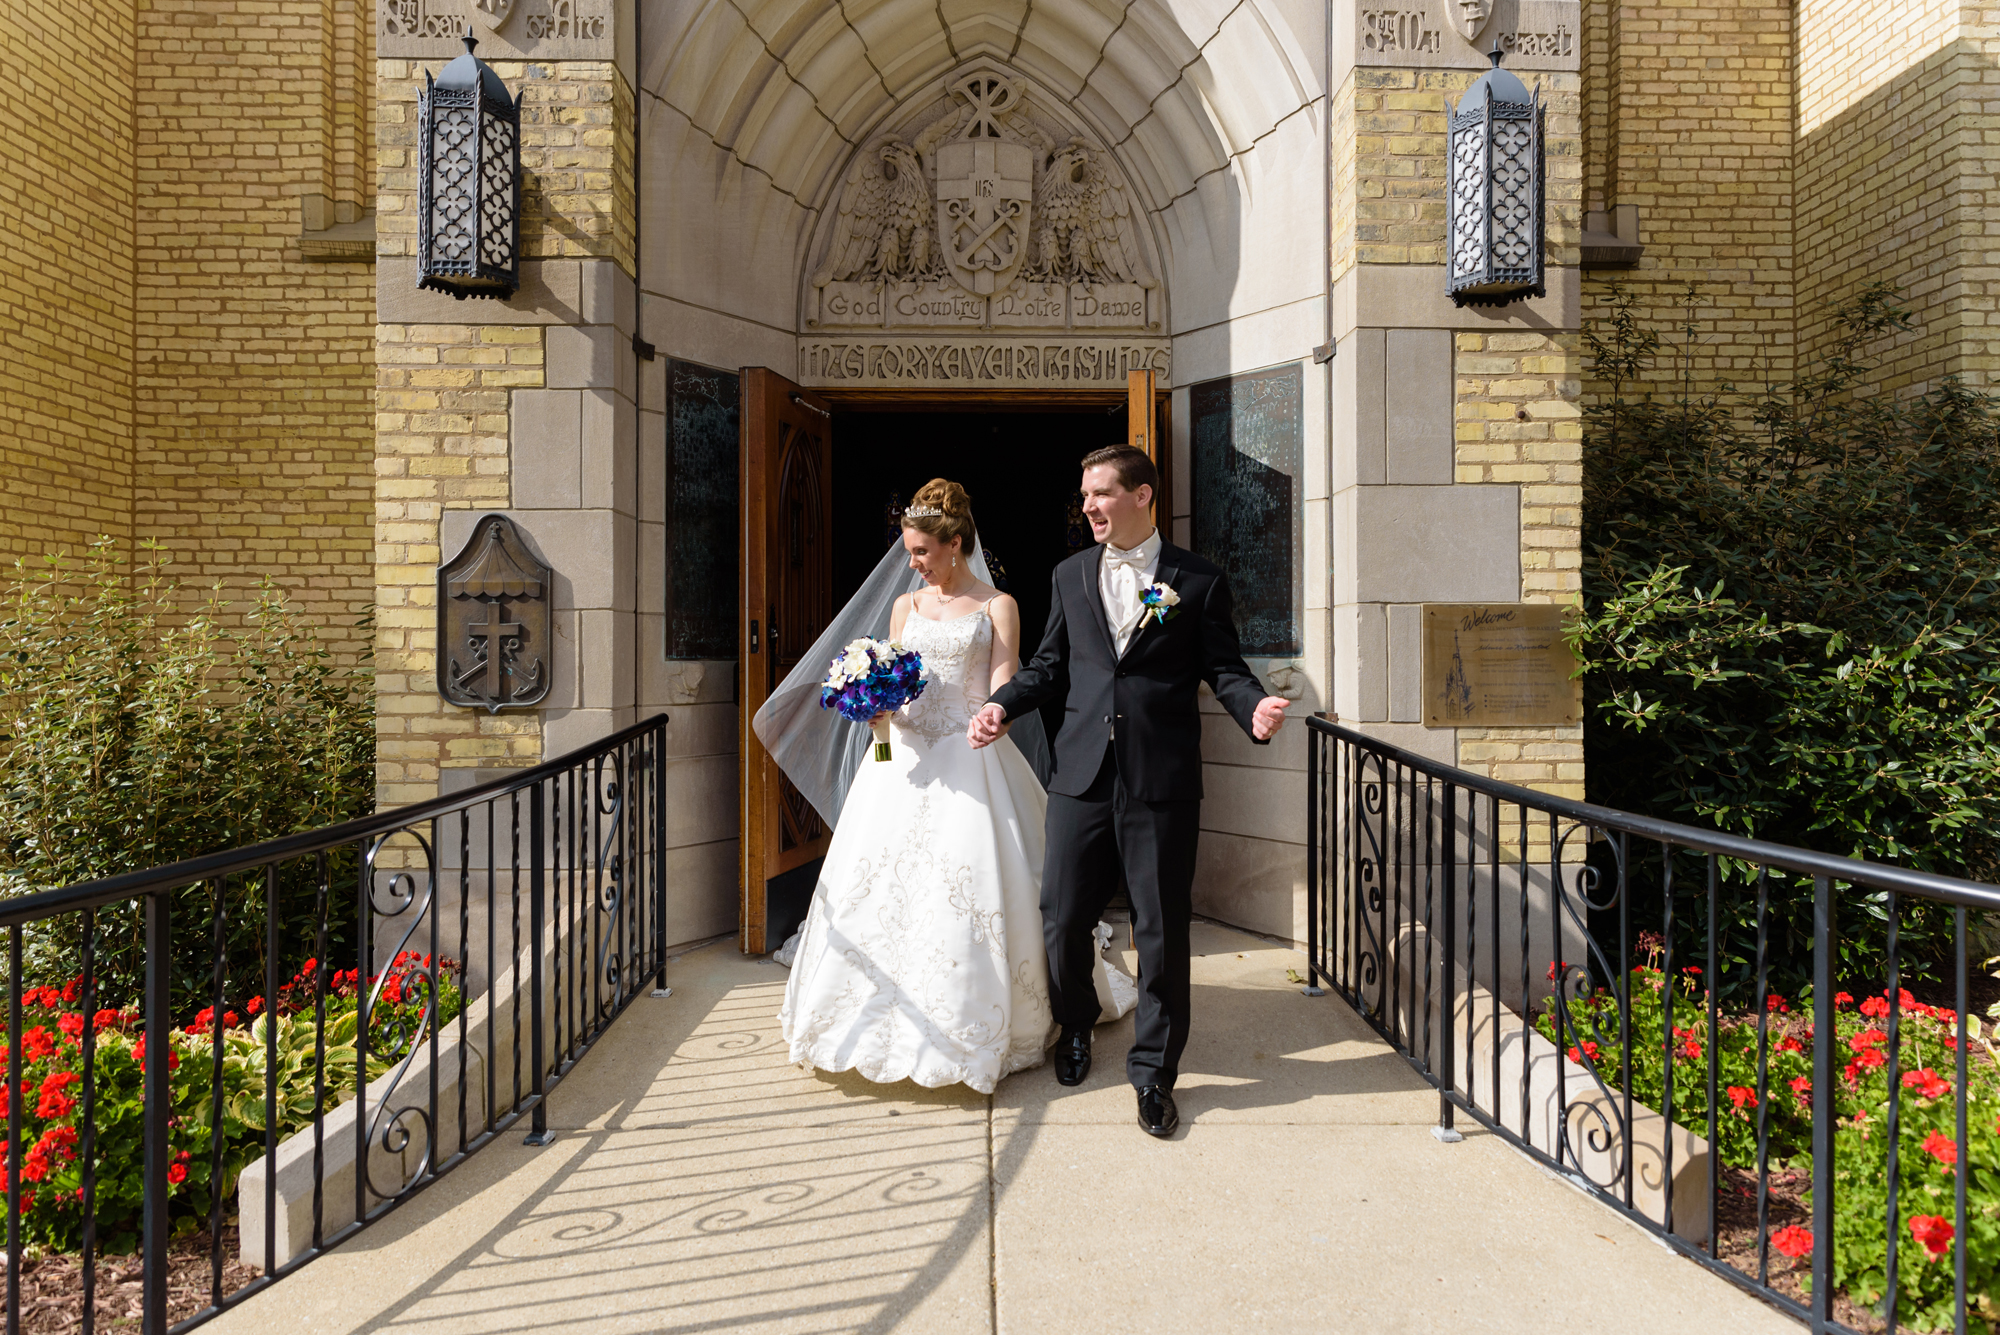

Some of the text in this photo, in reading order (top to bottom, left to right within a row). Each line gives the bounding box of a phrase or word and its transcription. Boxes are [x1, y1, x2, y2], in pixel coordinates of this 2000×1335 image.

[827, 292, 1142, 320] God Country Notre Dame
[1460, 608, 1517, 632] Welcome
